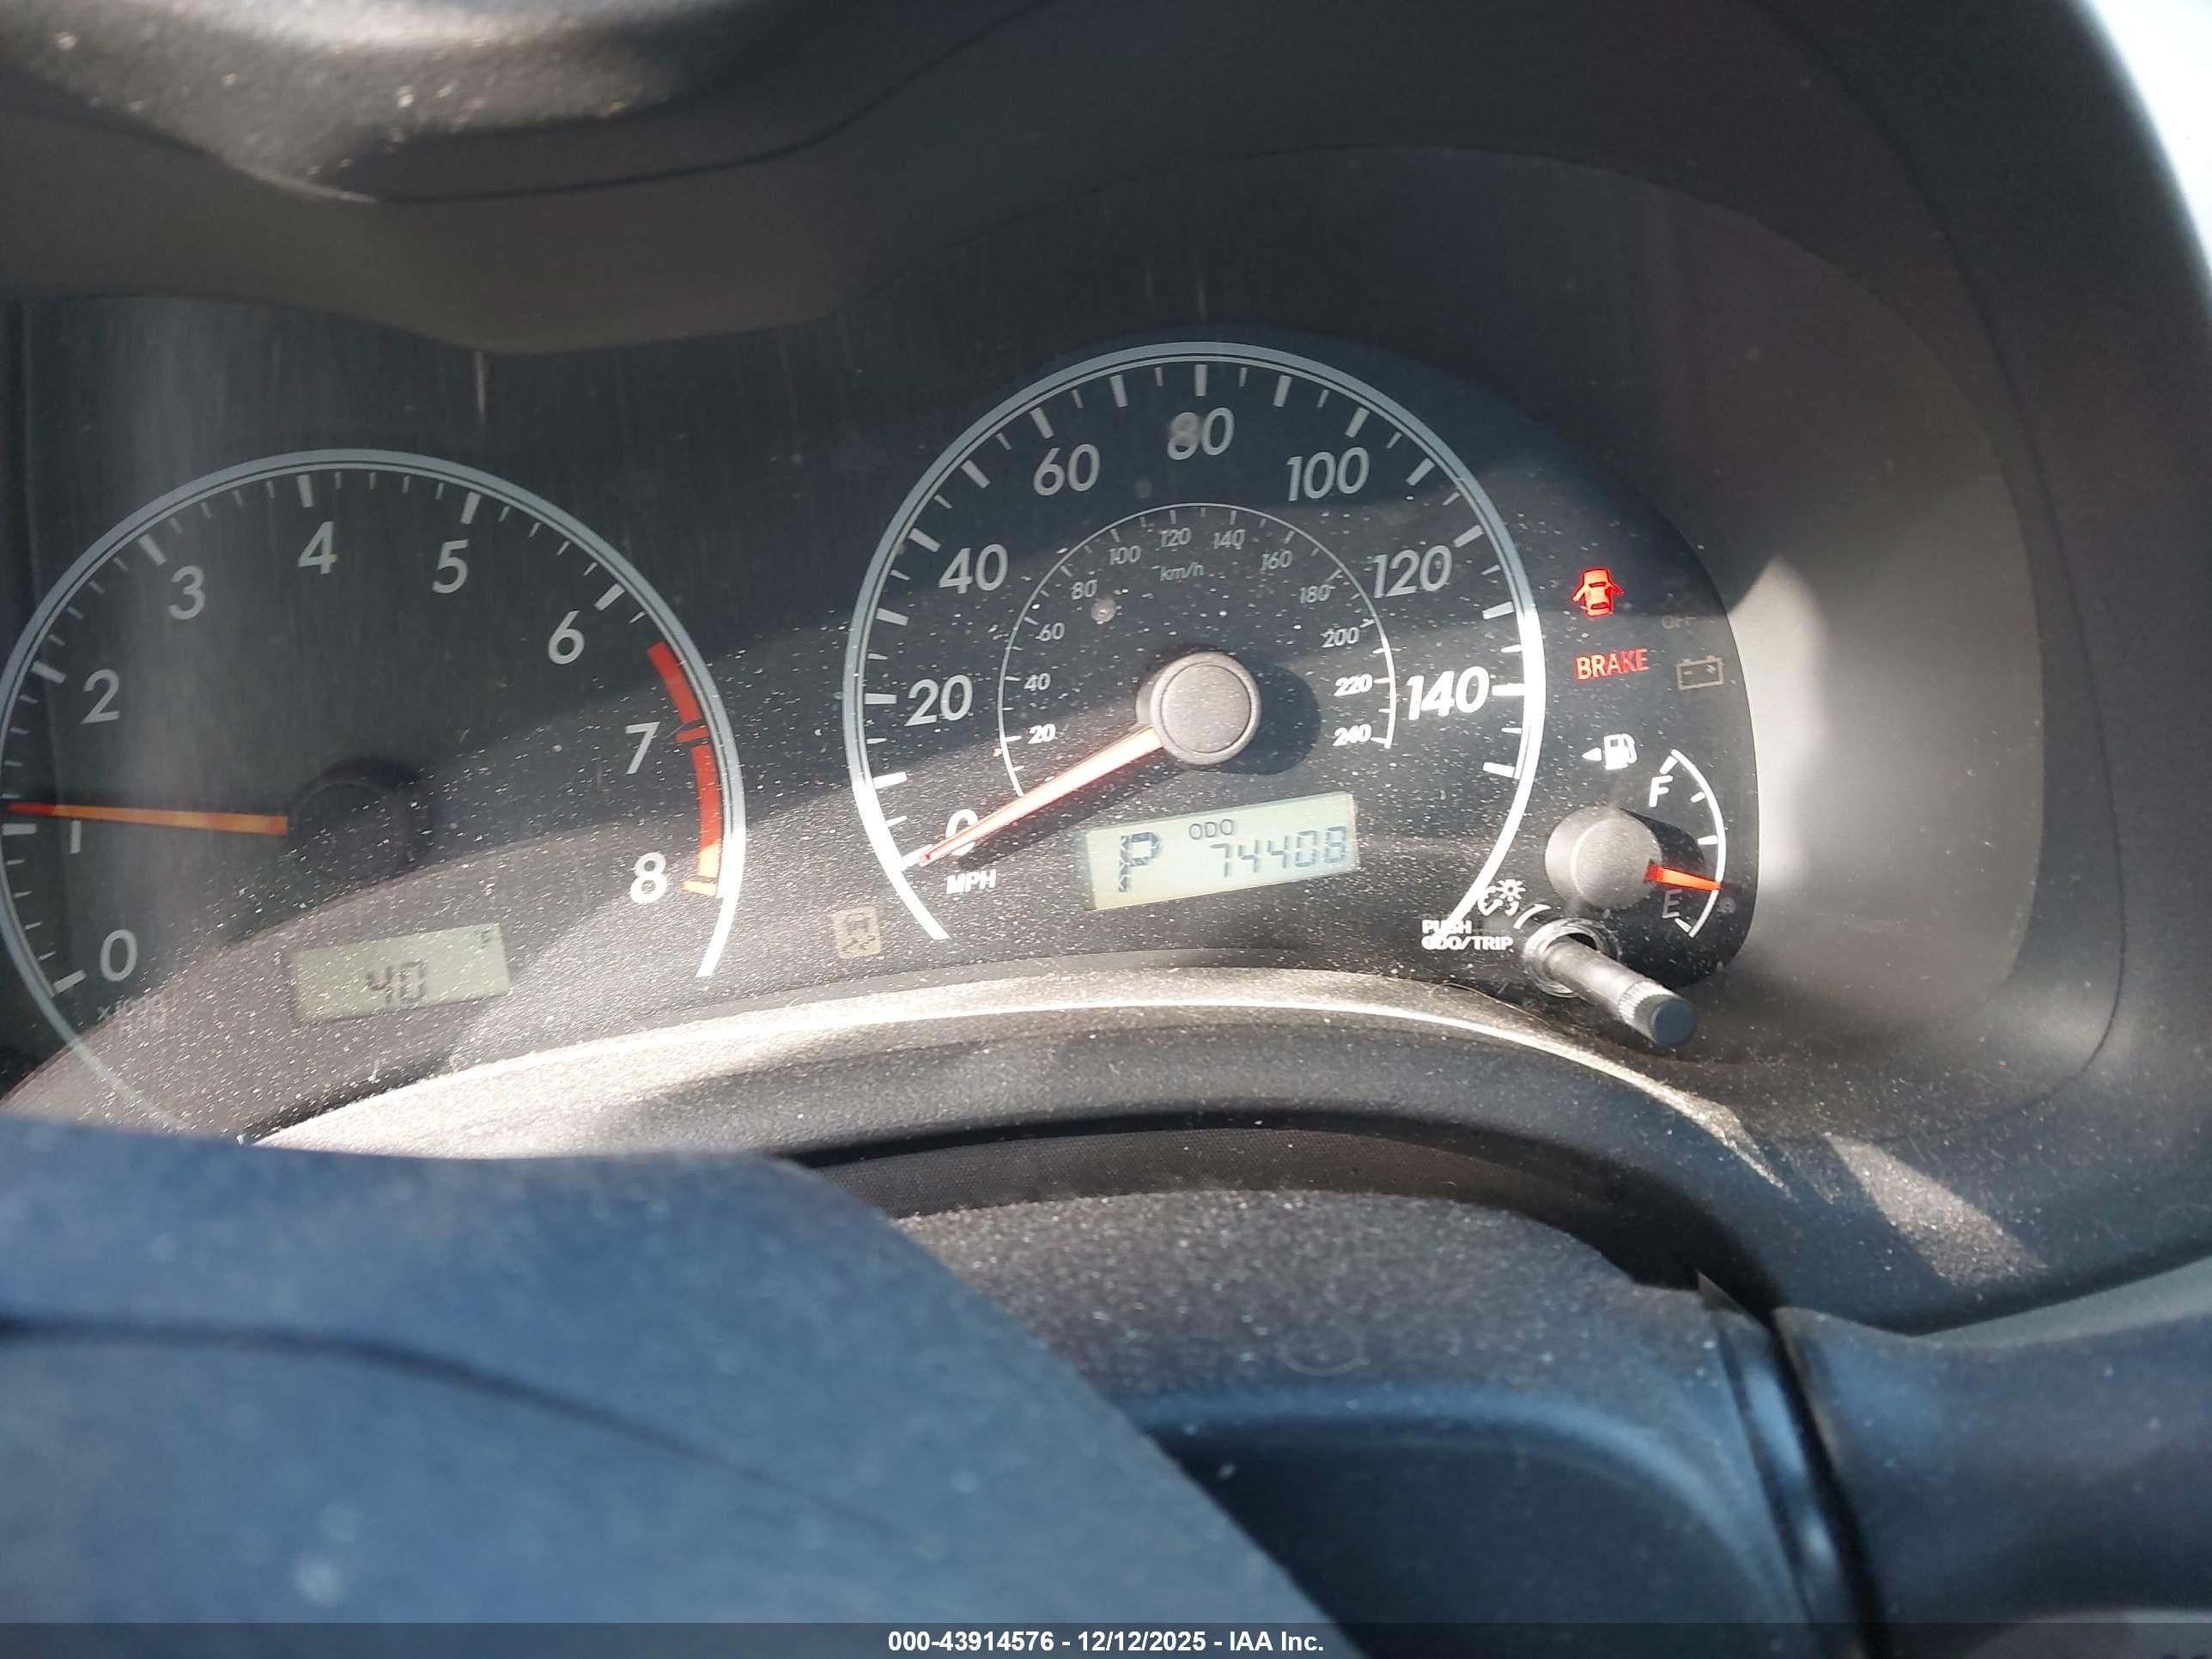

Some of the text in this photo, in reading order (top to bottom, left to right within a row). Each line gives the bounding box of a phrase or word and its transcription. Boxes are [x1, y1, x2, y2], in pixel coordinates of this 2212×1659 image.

[1168, 407, 1235, 460] 80
[1033, 443, 1101, 496] 60
[1287, 447, 1370, 501] 100
[298, 520, 337, 574] 4
[1108, 545, 1142, 565] 100
[1160, 527, 1192, 548] 120
[1213, 529, 1245, 550] 140
[432, 539, 469, 594] 5
[939, 543, 1008, 594] 40
[1159, 564, 1205, 581] km/h
[1261, 550, 1293, 572] 160
[1372, 545, 1453, 599] 120
[169, 564, 207, 620] 3
[1071, 579, 1098, 599] 80
[1299, 582, 1332, 604] 180
[547, 611, 586, 665] 6
[1038, 622, 1066, 641] 60
[1321, 627, 1360, 648] 200
[1024, 672, 1051, 691] 40
[1334, 674, 1373, 696] 220
[1575, 648, 1650, 680] BRAKE
[82, 669, 121, 724] 2
[904, 675, 975, 726] 20
[1407, 665, 1490, 720] 140
[624, 721, 659, 775] 7
[1029, 723, 1056, 744] 20
[1333, 724, 1371, 746] 240
[1648, 775, 1674, 807] F
[945, 808, 979, 856] 0
[1188, 818, 1233, 841] ODO
[1209, 825, 1347, 878] 74408
[629, 853, 667, 903] 8
[945, 869, 996, 894] MPH
[1117, 831, 1161, 893] P
[1663, 890, 1680, 919] E
[100, 929, 137, 982] 0
[366, 960, 426, 1005] 40
